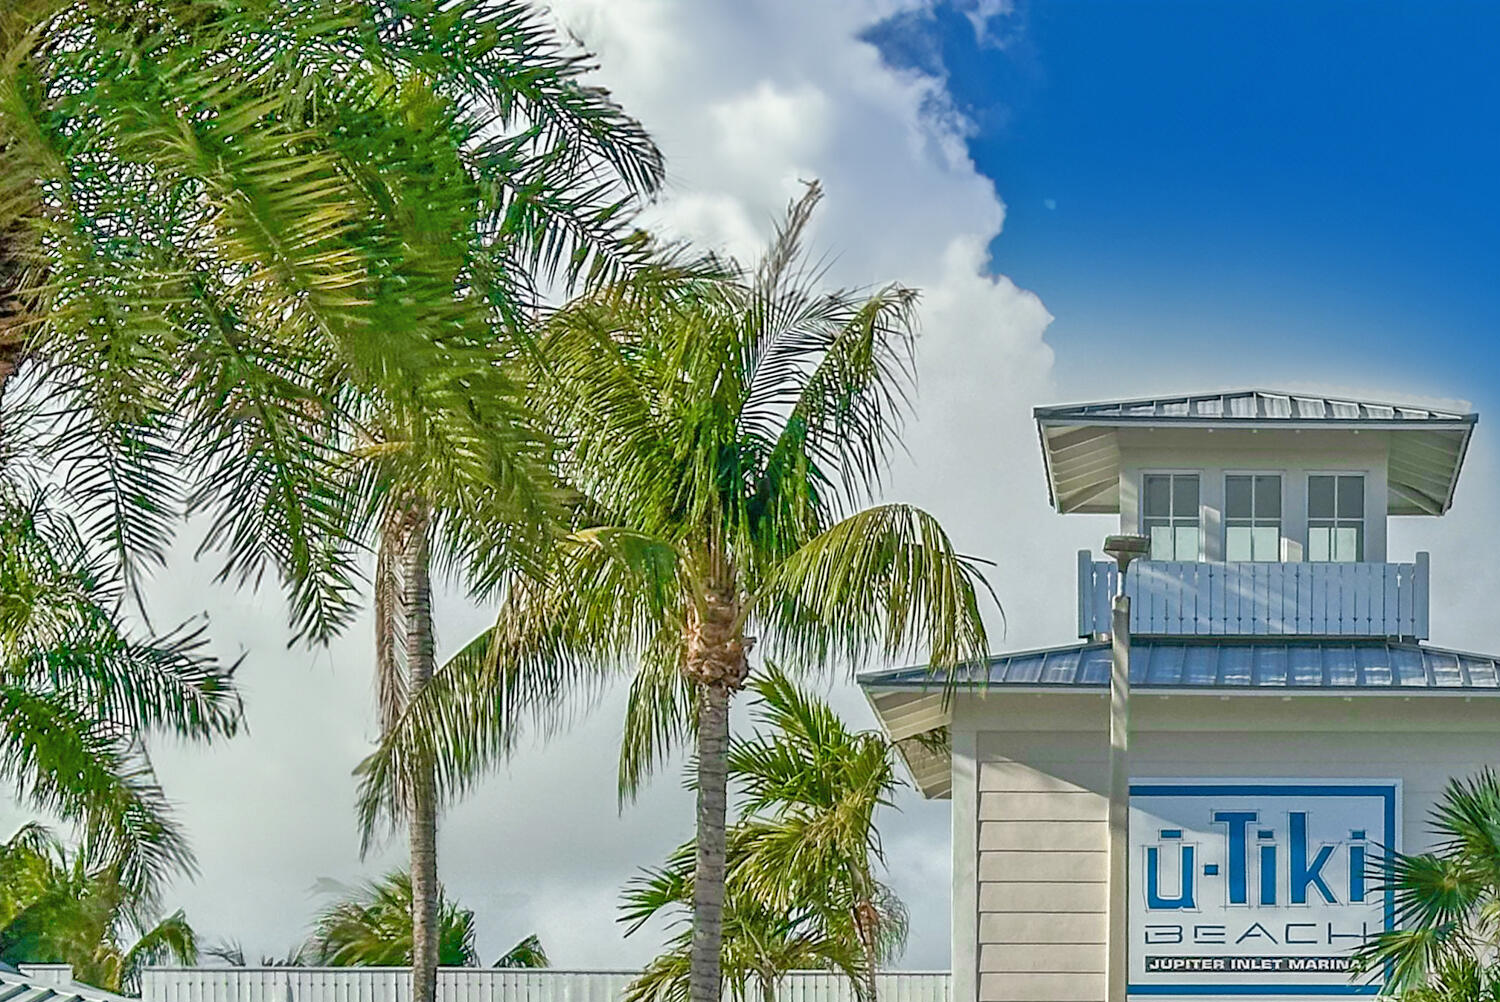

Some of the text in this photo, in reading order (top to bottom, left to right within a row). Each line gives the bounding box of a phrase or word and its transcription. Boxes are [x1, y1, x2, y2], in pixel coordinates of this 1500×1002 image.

[1145, 922, 1367, 945] BEACH
[1149, 958, 1225, 970] JUPITER
[1230, 958, 1283, 970] INLET
